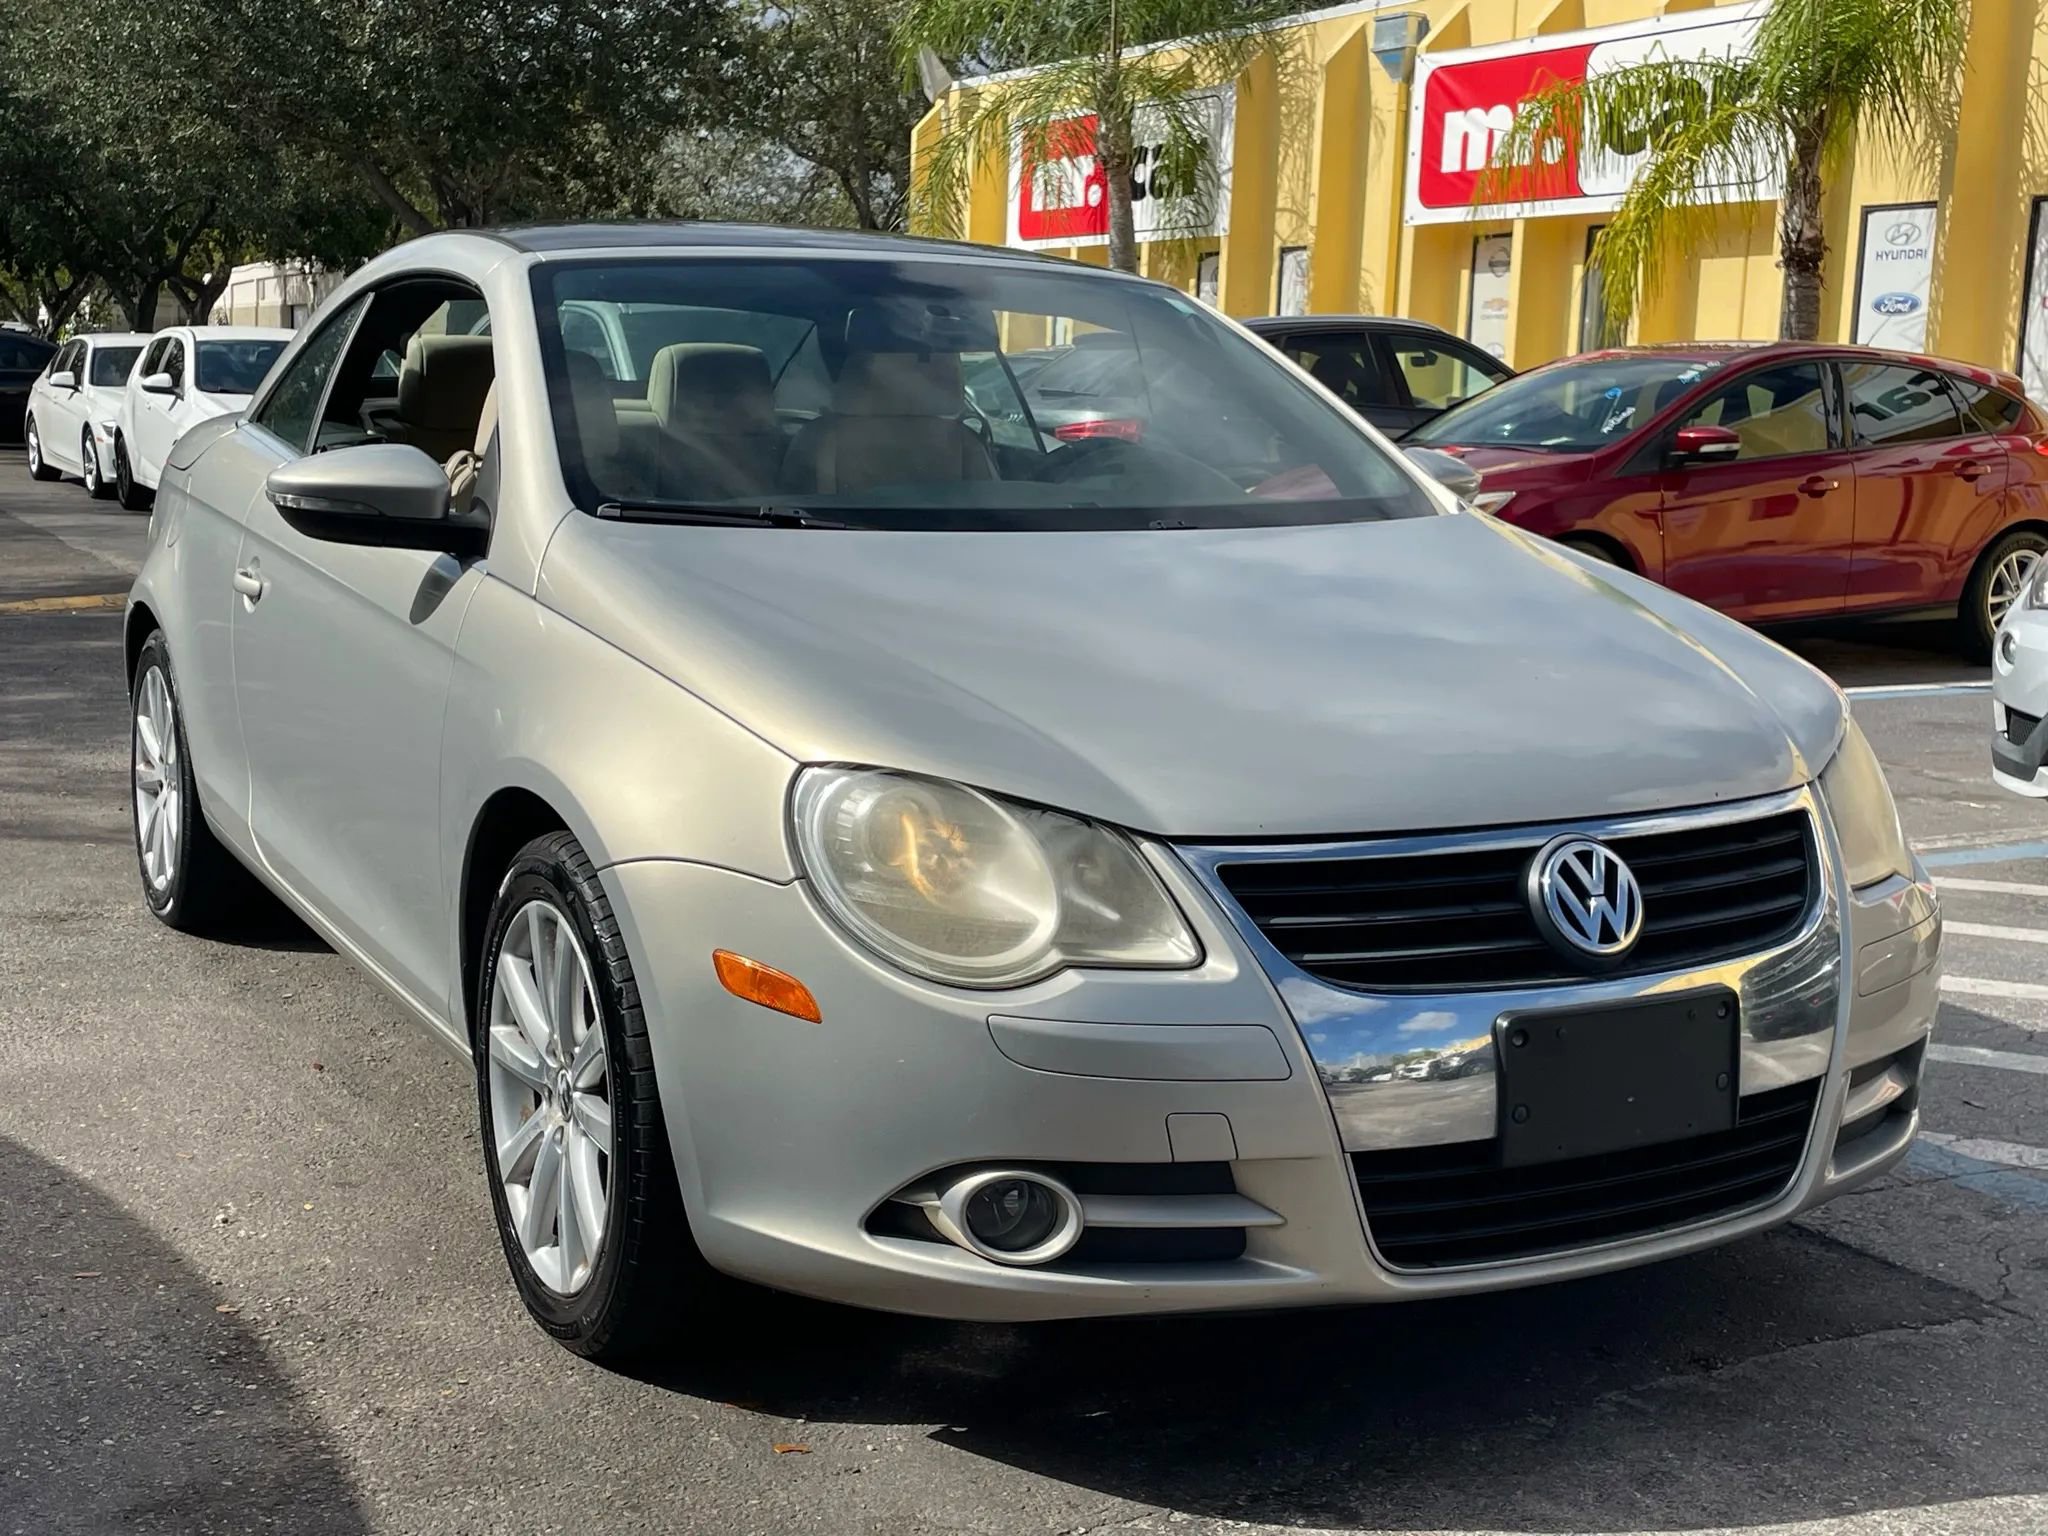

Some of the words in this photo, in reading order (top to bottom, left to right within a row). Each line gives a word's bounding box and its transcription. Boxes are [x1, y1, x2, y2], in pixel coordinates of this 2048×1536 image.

[1876, 249, 1928, 261] HYUNDAI
[1880, 296, 1912, 312] Ford
[1550, 845, 1636, 949] VW
